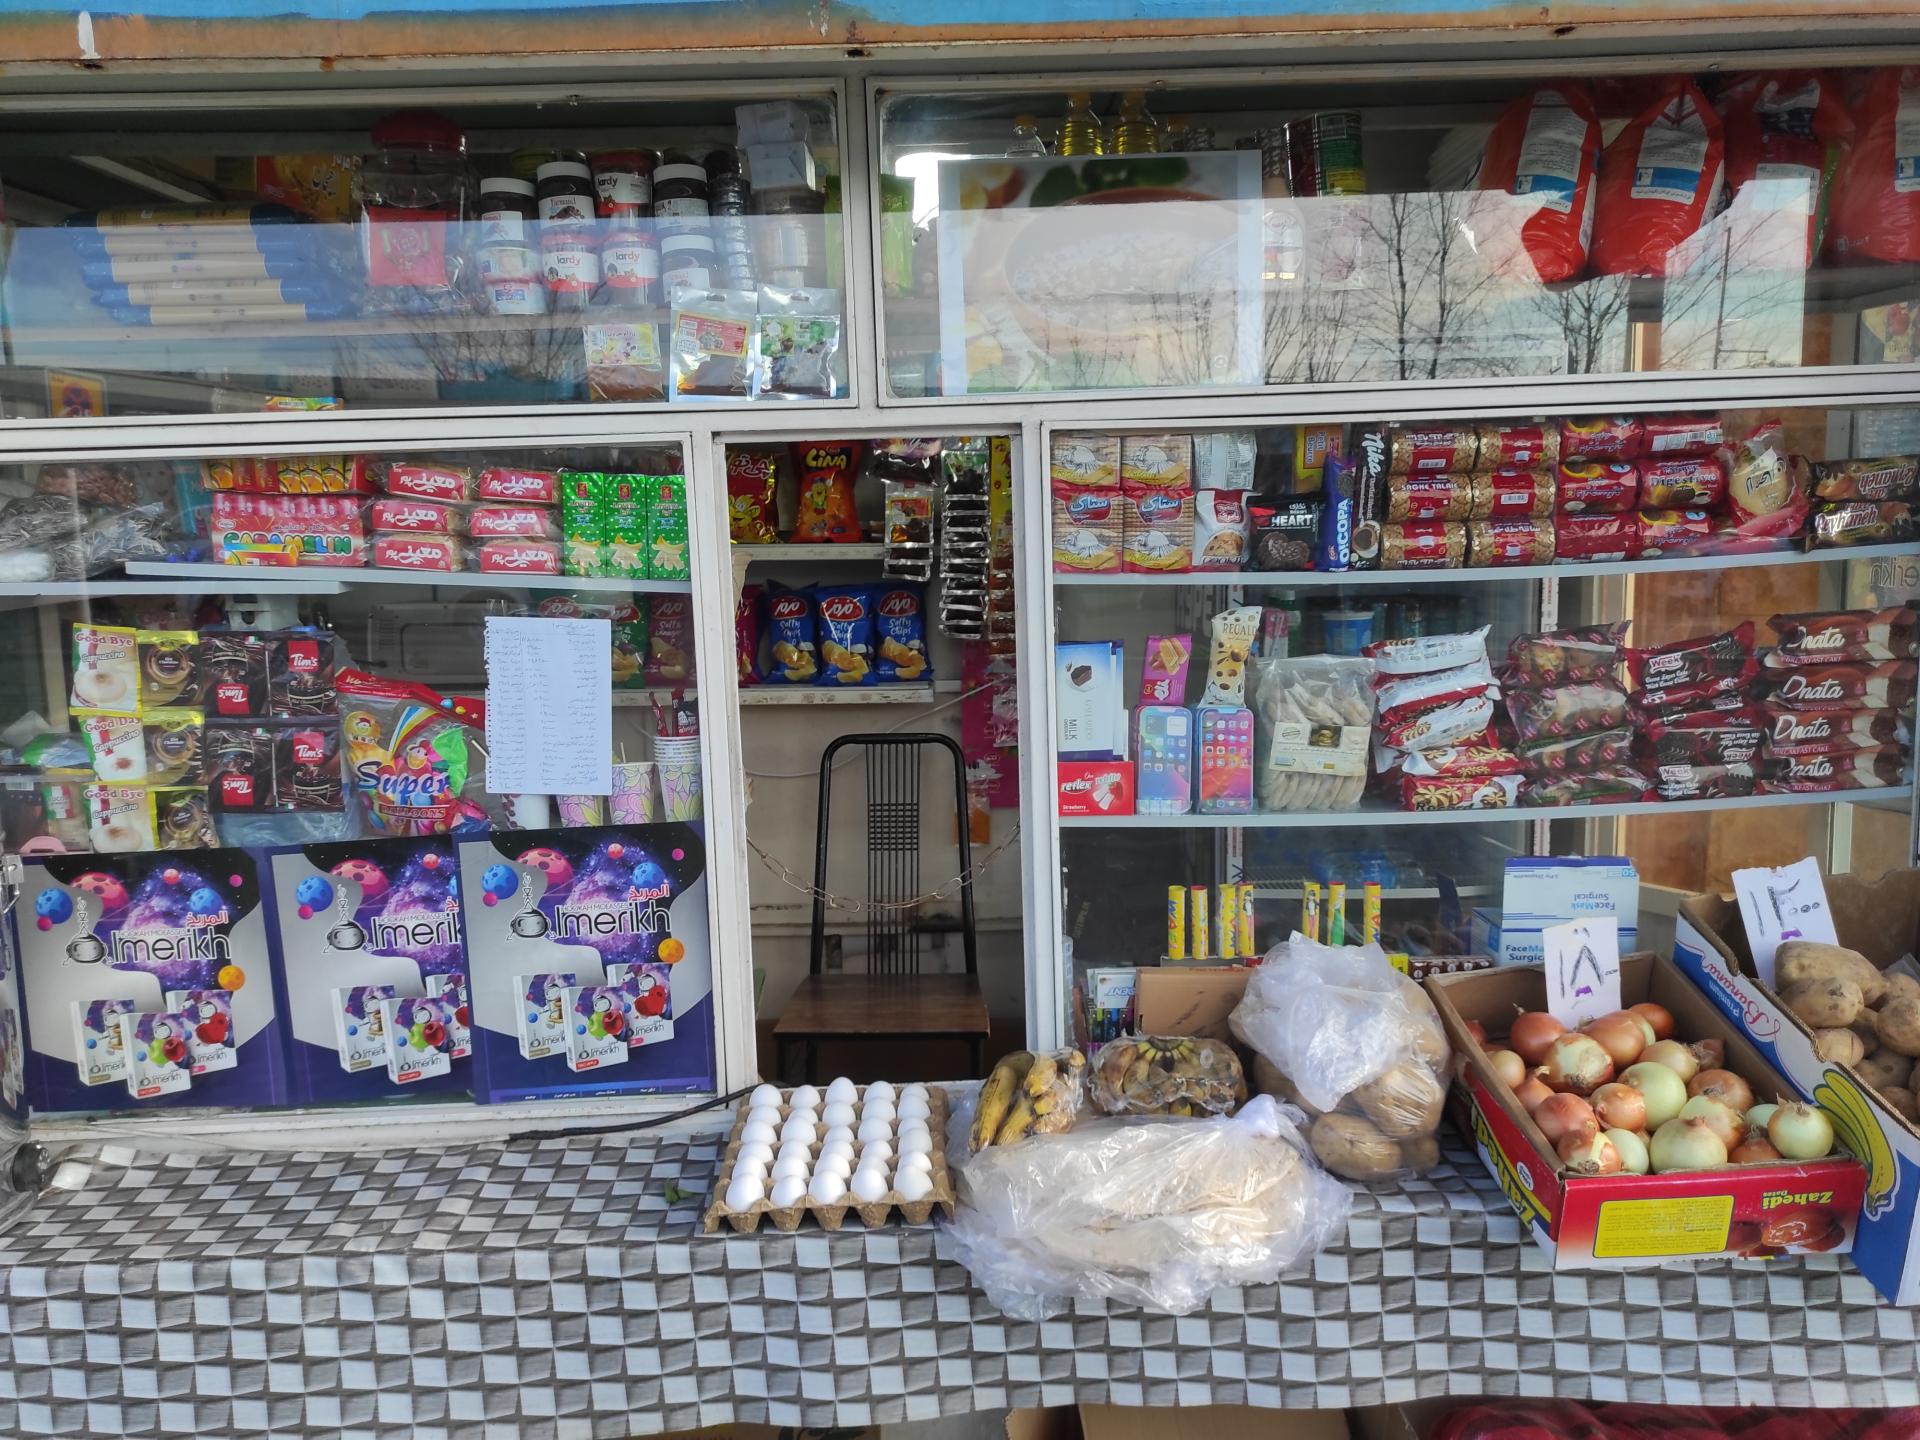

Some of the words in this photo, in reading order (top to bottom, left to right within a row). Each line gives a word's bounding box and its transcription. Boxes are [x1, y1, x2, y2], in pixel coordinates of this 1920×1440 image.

[597, 175, 618, 188] lardy
[557, 254, 582, 266] lardy
[616, 251, 640, 262] lardy
[1316, 431, 1327, 450] Petit
[1361, 432, 1386, 477] Nika
[1650, 472, 1717, 487] Digestive
[1070, 495, 1108, 512] ستاک
[1141, 495, 1178, 512] ستاک
[1271, 514, 1313, 527] HEART
[1336, 498, 1351, 564] O!COPA
[774, 597, 800, 616] jojo
[827, 598, 854, 617] jojo
[885, 593, 911, 613] jojo
[888, 618, 912, 628] Salty
[890, 626, 912, 636] Chips
[75, 632, 109, 644] Good
[110, 636, 133, 647] Bye
[290, 653, 319, 666] Tim's
[1650, 654, 1682, 668] Week
[1782, 675, 1844, 699] Dnata
[218, 688, 248, 702] Tim's
[85, 718, 115, 732] Good
[1068, 718, 1079, 740] MILK
[1773, 715, 1831, 741] Dnata
[93, 730, 140, 753] Cappuccino
[295, 744, 323, 758] Tim's
[1723, 752, 1752, 760] Week
[1810, 745, 1830, 754] CAKE
[1660, 766, 1690, 776] Week
[223, 780, 252, 794] Tim's
[357, 760, 450, 806] Super
[1061, 778, 1093, 792] reflex
[84, 789, 118, 799] Good
[120, 789, 145, 799] Bye
[93, 802, 138, 820] Cappuccino
[1622, 868, 1637, 878] 50
[1574, 892, 1610, 901] Surgical
[1570, 902, 1616, 911] FaceMask
[371, 912, 460, 949] Imerik
[1505, 944, 1544, 954] FaceMa
[1508, 952, 1544, 963] Surgic
[1708, 962, 1770, 1025] Banana
[1762, 1190, 1788, 1198] Dates
[1762, 1191, 1833, 1210] Zahedi
